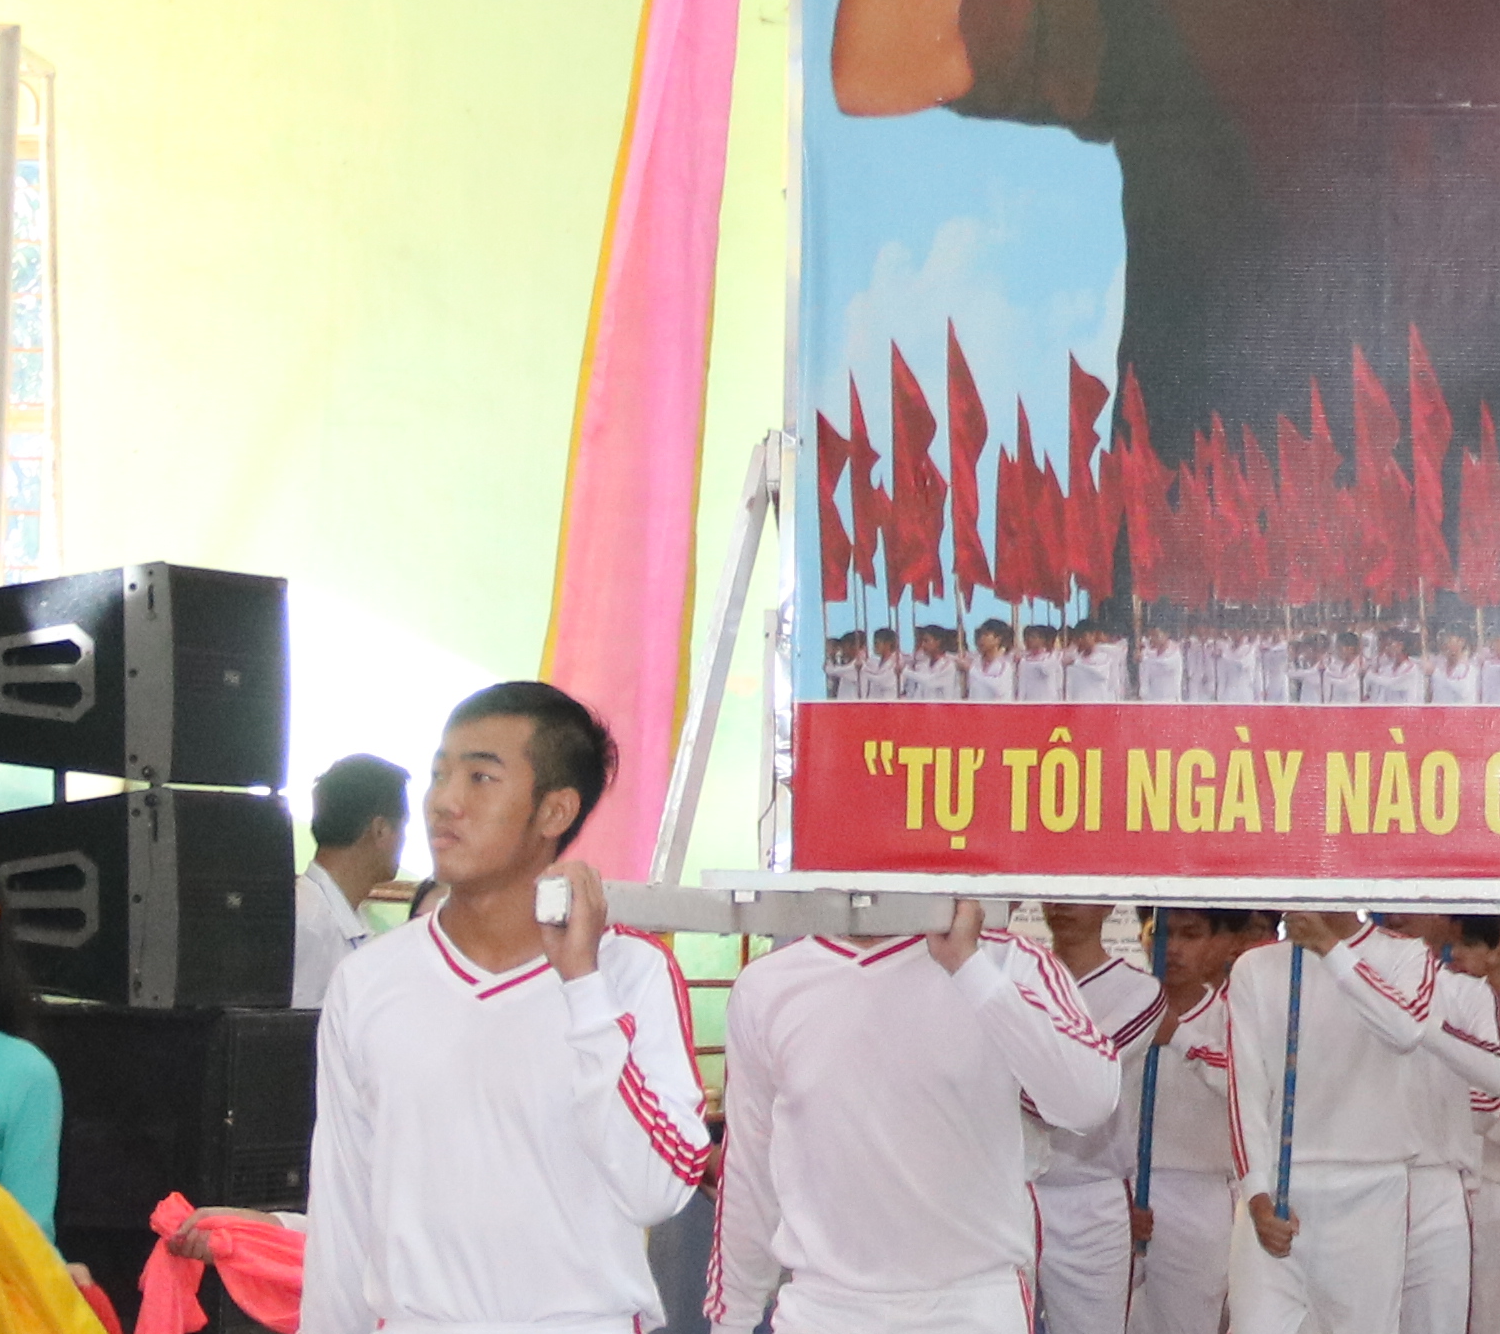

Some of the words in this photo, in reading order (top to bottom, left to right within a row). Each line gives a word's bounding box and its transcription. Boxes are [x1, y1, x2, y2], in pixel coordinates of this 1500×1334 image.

[1002, 727, 1102, 832] TÔI
[1126, 725, 1303, 833] NGÀY
[1325, 727, 1462, 835] NÀO
